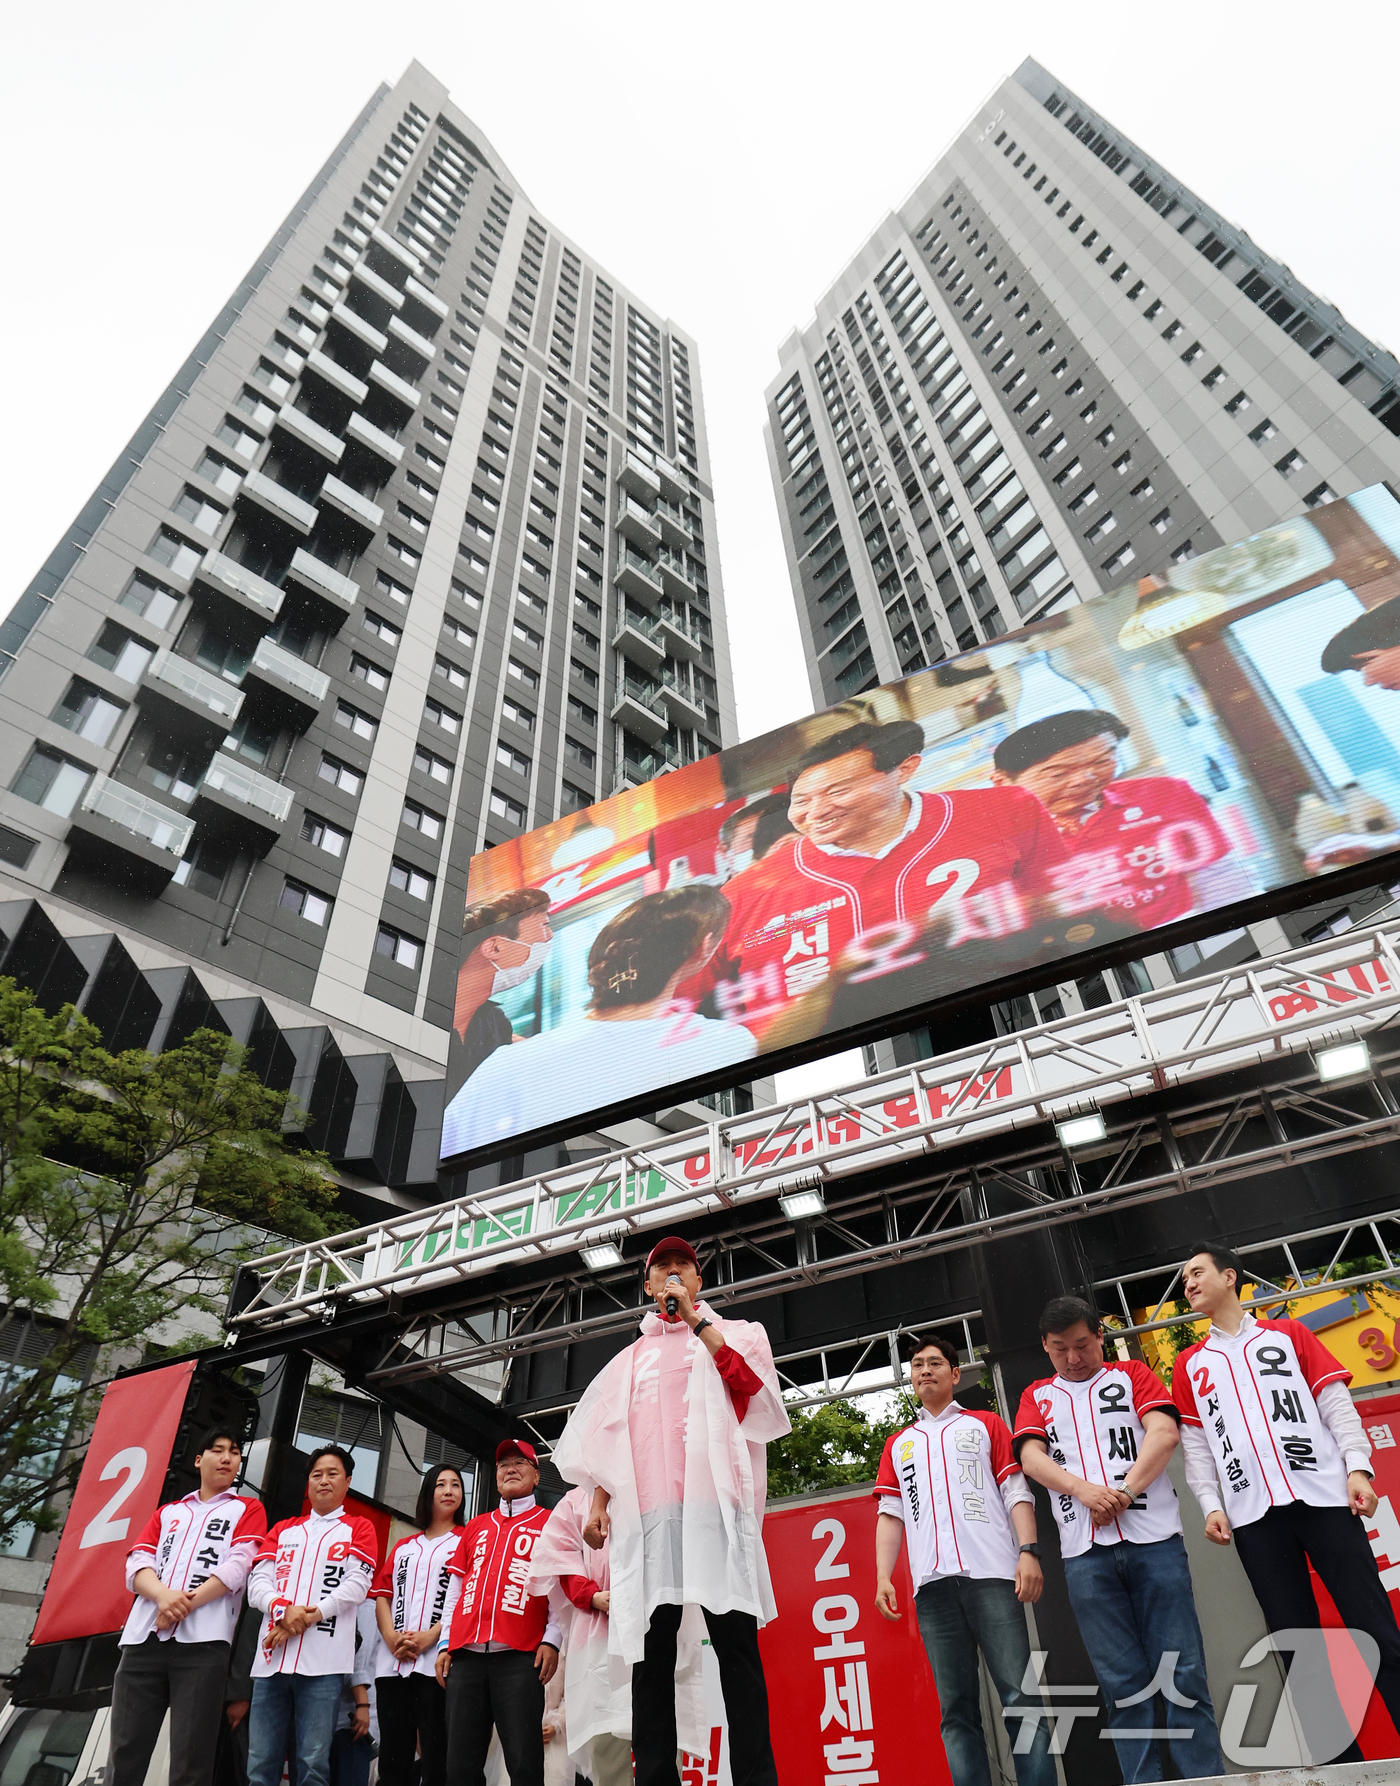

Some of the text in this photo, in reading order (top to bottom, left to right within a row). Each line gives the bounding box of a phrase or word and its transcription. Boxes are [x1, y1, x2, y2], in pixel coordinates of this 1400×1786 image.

[634, 1347, 662, 1385] 2
[1193, 1366, 1251, 1493] 2 서울시장 후보
[1256, 1346, 1319, 1472] 오세훈
[900, 1440, 915, 1463] 2
[954, 1428, 990, 1524] 장지호
[1037, 1398, 1054, 1427] 2
[1063, 1510, 1077, 1524] 후보
[79, 1446, 148, 1549] 2
[168, 1519, 180, 1533] 2
[332, 1544, 345, 1559] 2
[476, 1529, 489, 1545] 2
[811, 1518, 850, 1582] 2
[462, 1543, 487, 1608] 서울시의원
[501, 1533, 541, 1616] 이종환
